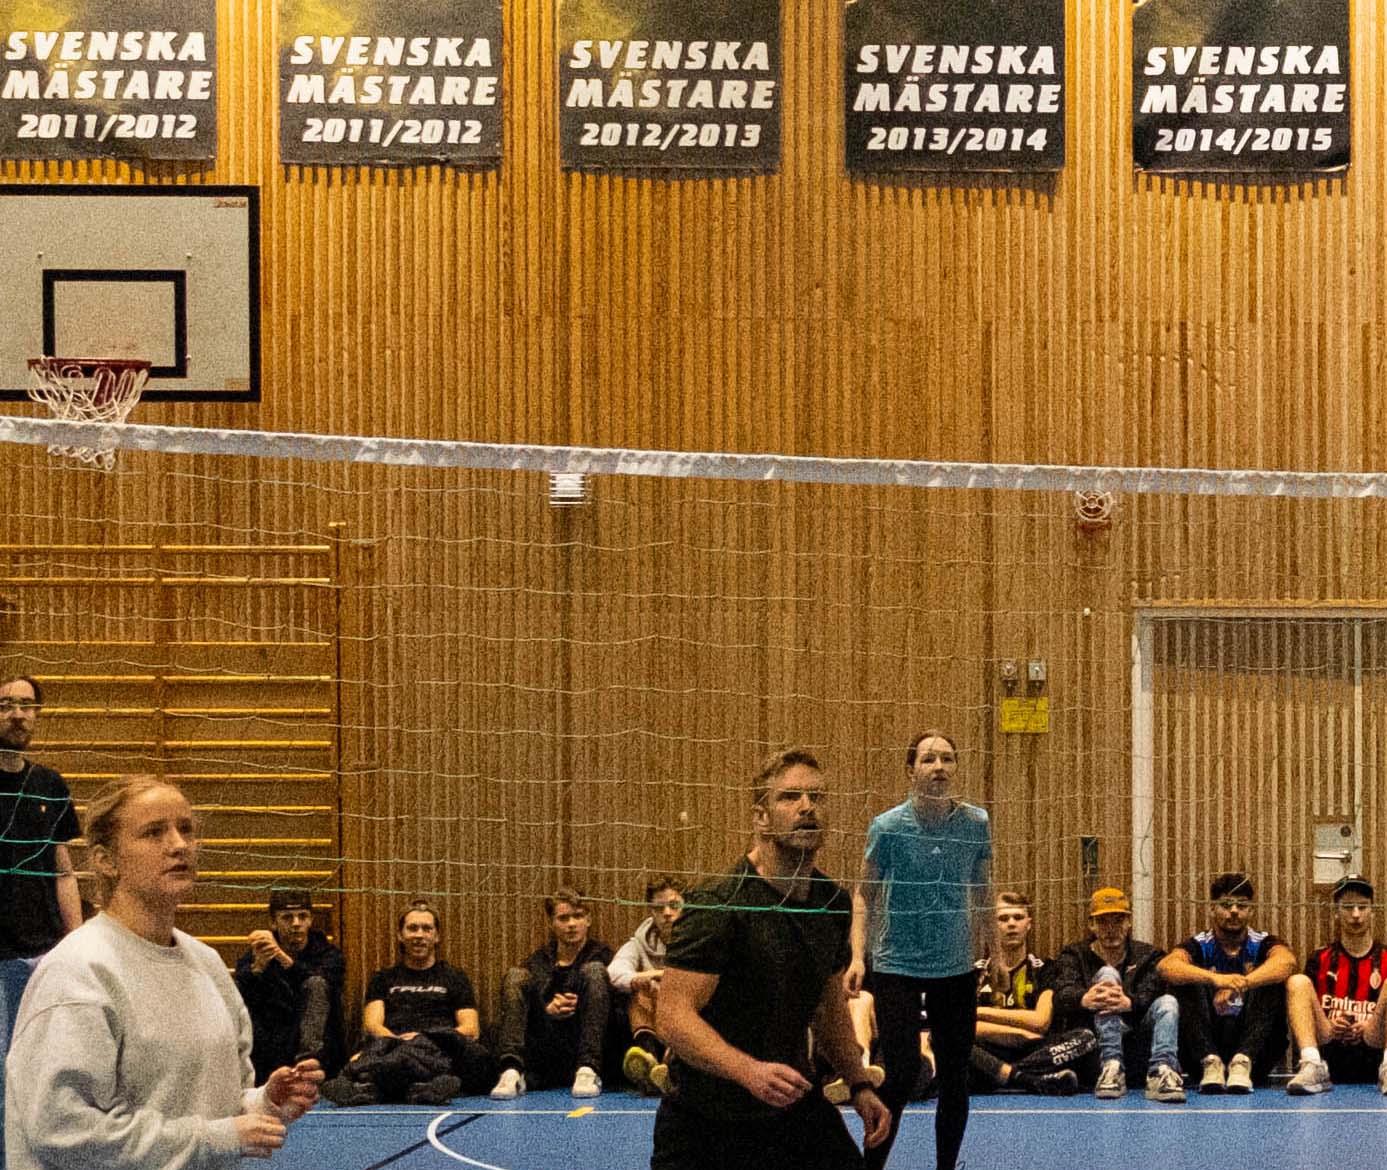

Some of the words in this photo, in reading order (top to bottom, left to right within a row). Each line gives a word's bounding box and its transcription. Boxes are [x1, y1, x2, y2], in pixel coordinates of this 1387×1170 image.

[4, 30, 207, 62] SVENSKA
[289, 36, 492, 67] SVENSKA
[569, 40, 770, 71] SVENSKA
[856, 44, 1056, 75] SVENSKA
[1143, 45, 1341, 76] SVENSKA
[1, 62, 213, 100] MÄSTARE
[286, 67, 498, 106] MÄSTARE
[565, 71, 776, 109] MÄSTARE
[853, 75, 1062, 113] MÄSTARE
[1139, 76, 1347, 114] MÄSTARE
[17, 113, 198, 142] 2011/2012
[301, 117, 483, 148] 2011/2012
[580, 122, 762, 151] 2012/2013
[867, 127, 1047, 155] 2013/2014
[1154, 127, 1333, 155] 2014/2015
[1321, 994, 1378, 1013] Emirate
